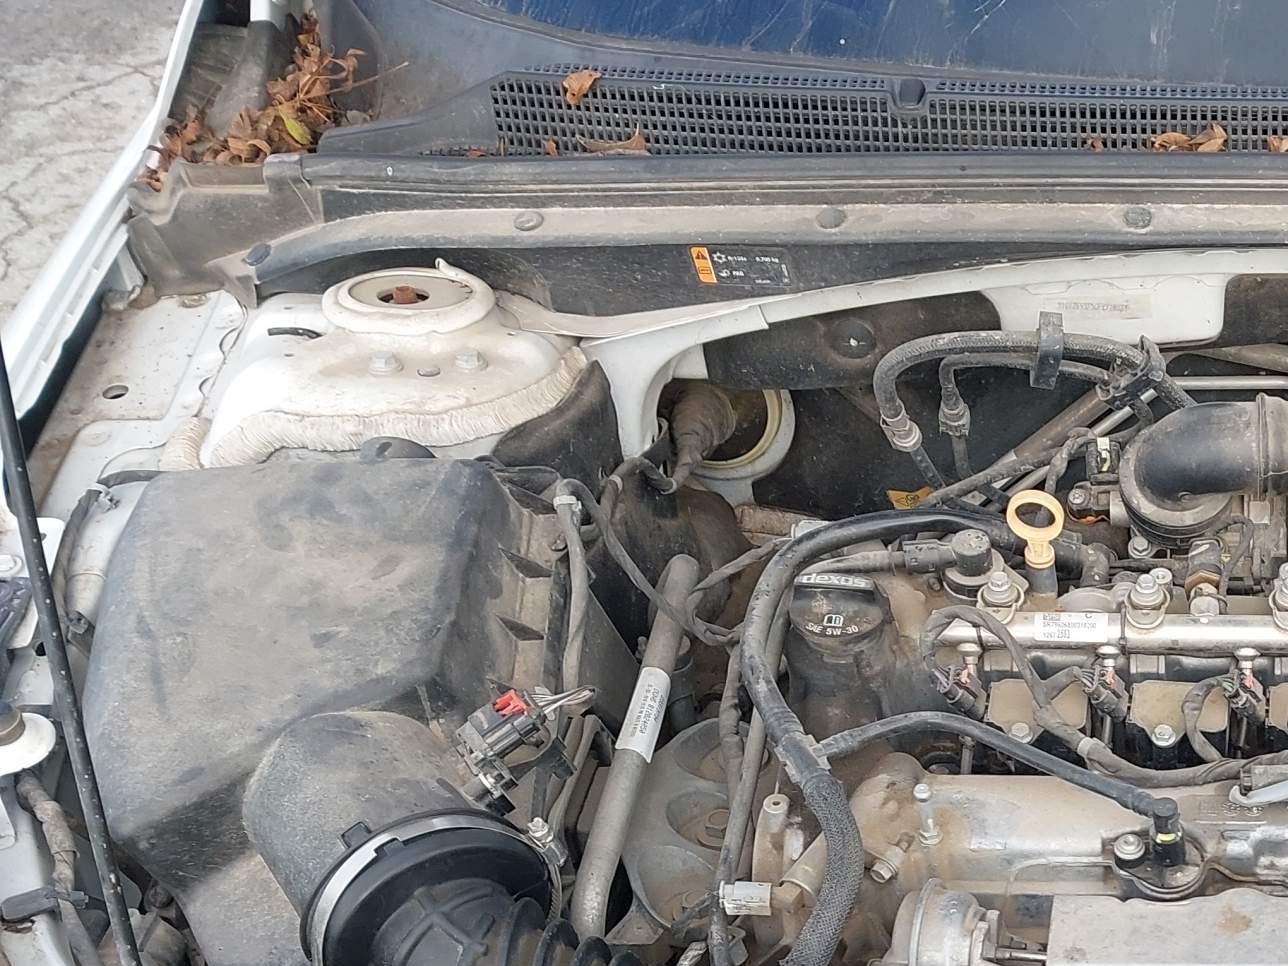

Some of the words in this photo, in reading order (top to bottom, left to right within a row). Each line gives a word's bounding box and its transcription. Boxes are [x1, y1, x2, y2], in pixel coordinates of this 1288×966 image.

[802, 573, 867, 588] dexos
[805, 622, 824, 634] SAE
[825, 625, 859, 636] 5W-30
